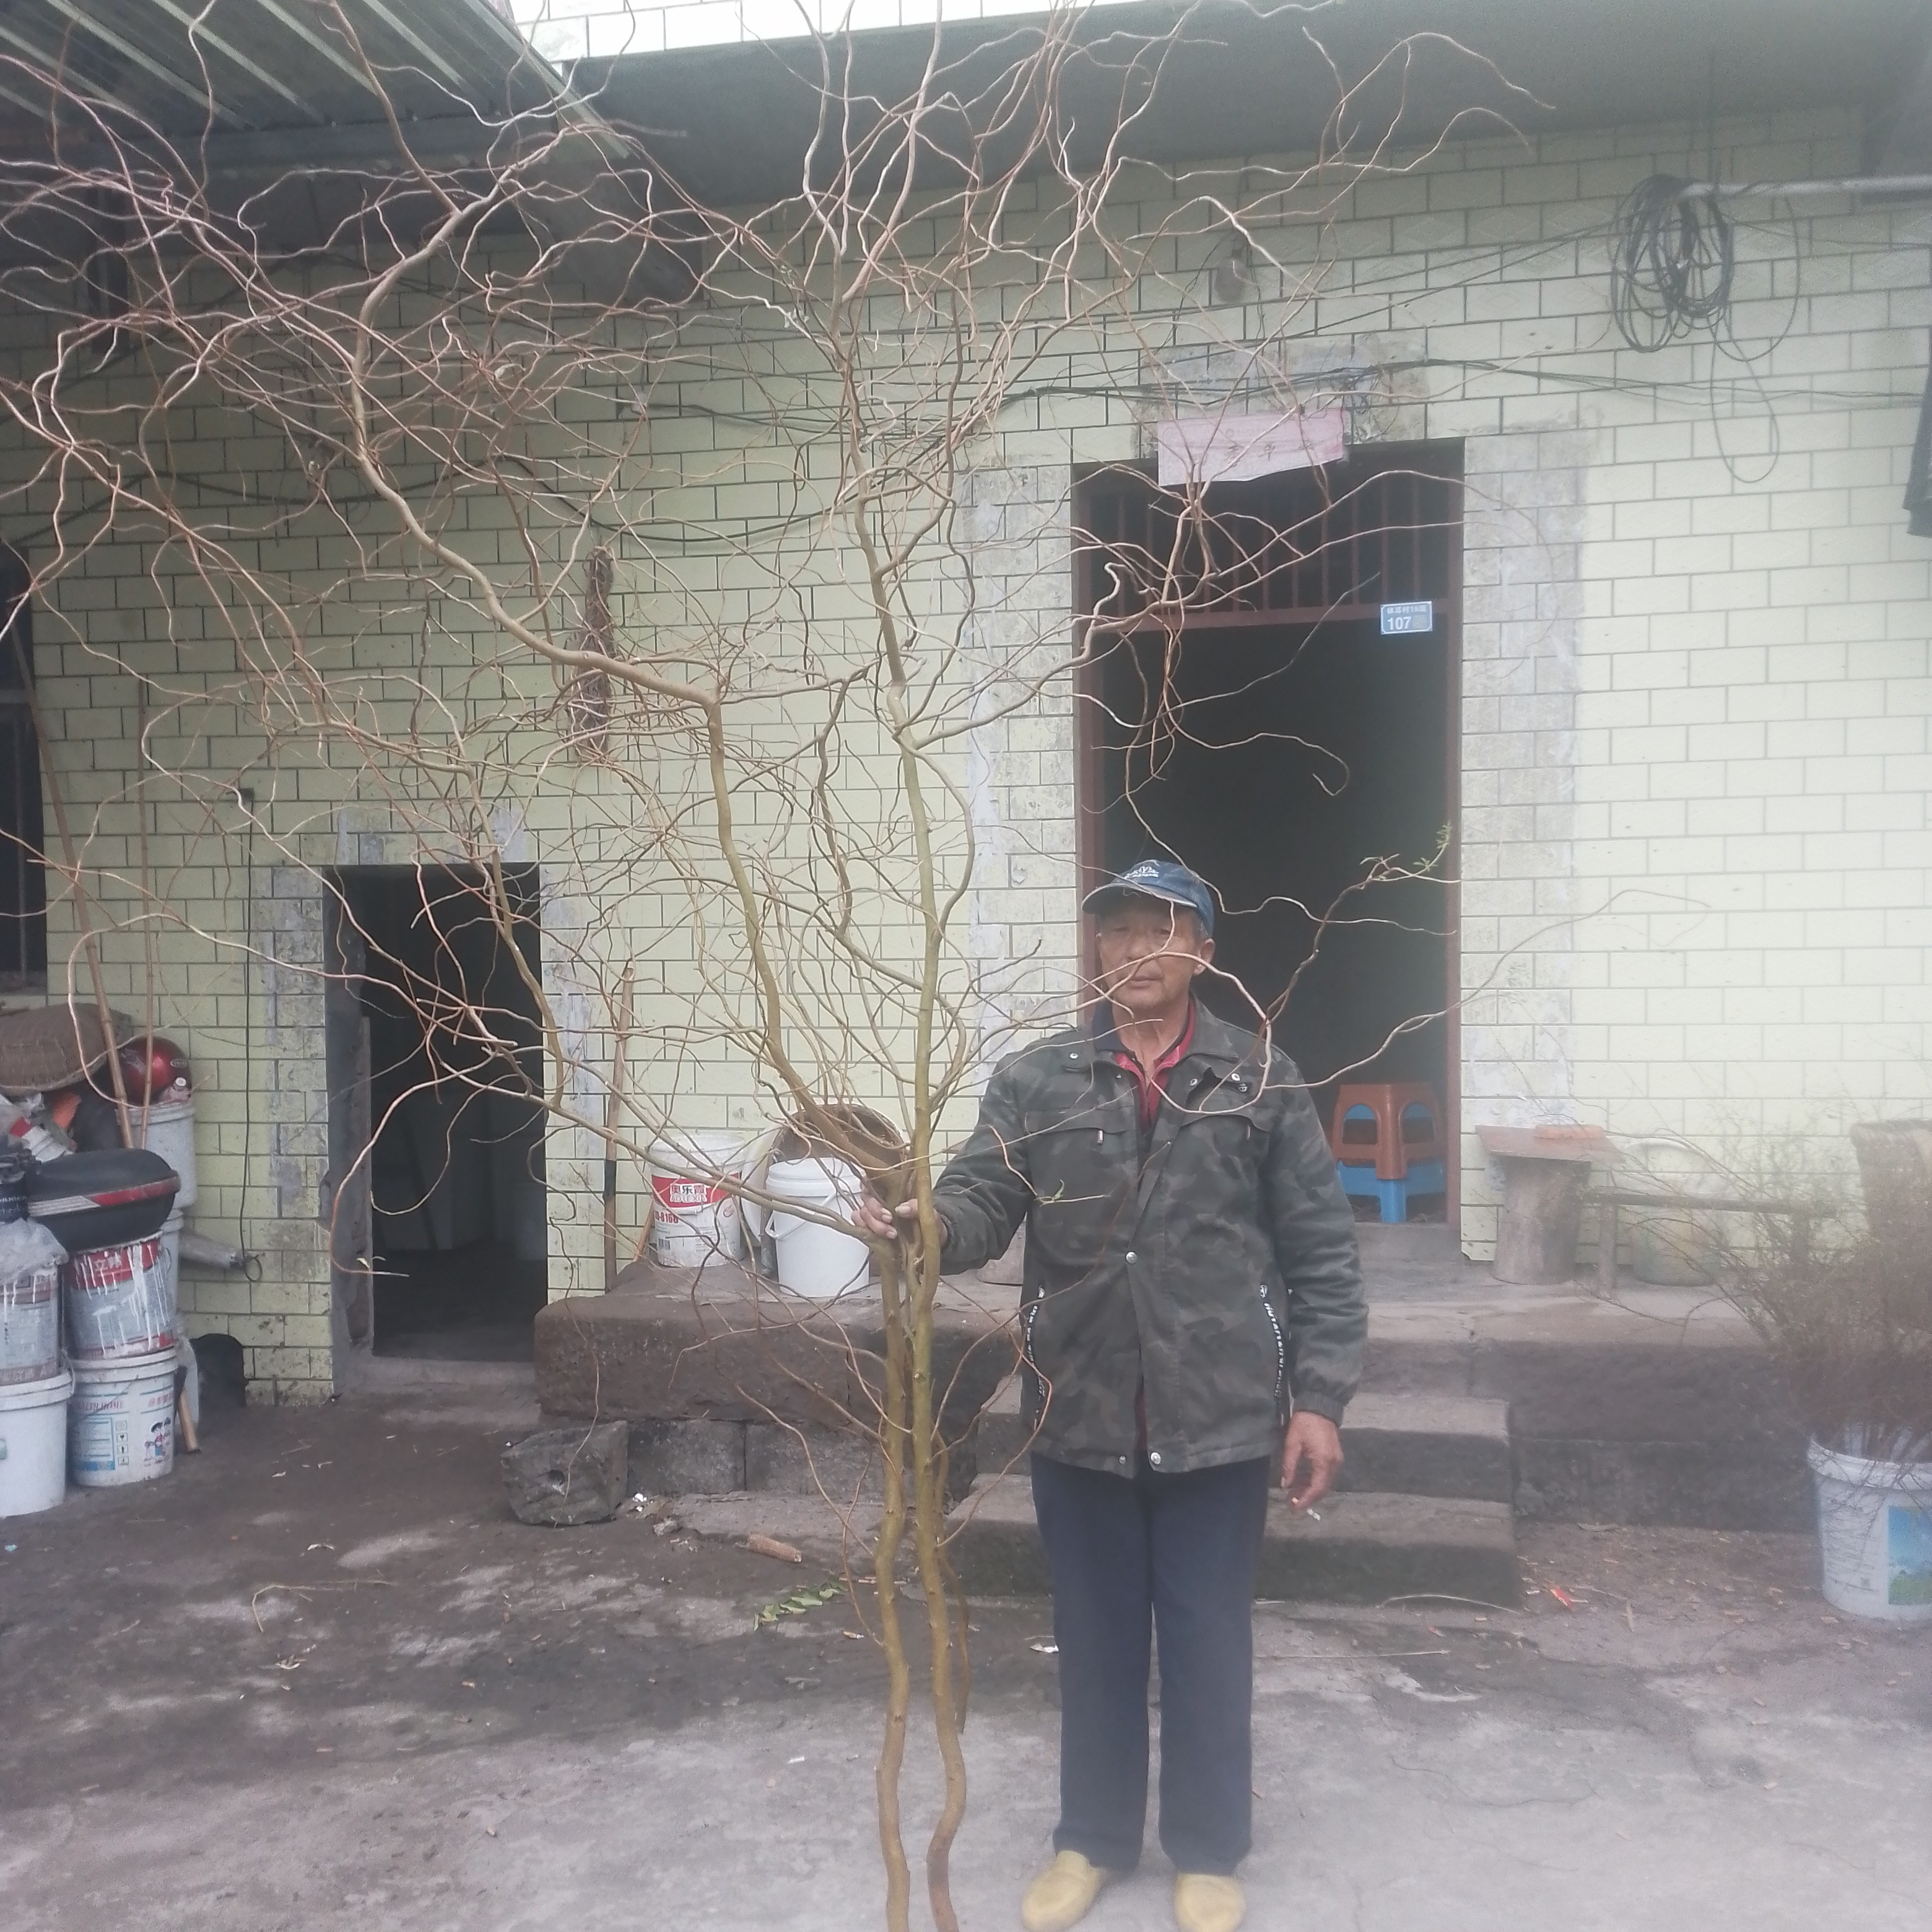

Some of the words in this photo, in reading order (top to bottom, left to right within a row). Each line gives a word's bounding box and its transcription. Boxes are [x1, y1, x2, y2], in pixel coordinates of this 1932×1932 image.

[1387, 616, 1411, 630] 107
[671, 1185, 705, 1194] 奥乐霞
